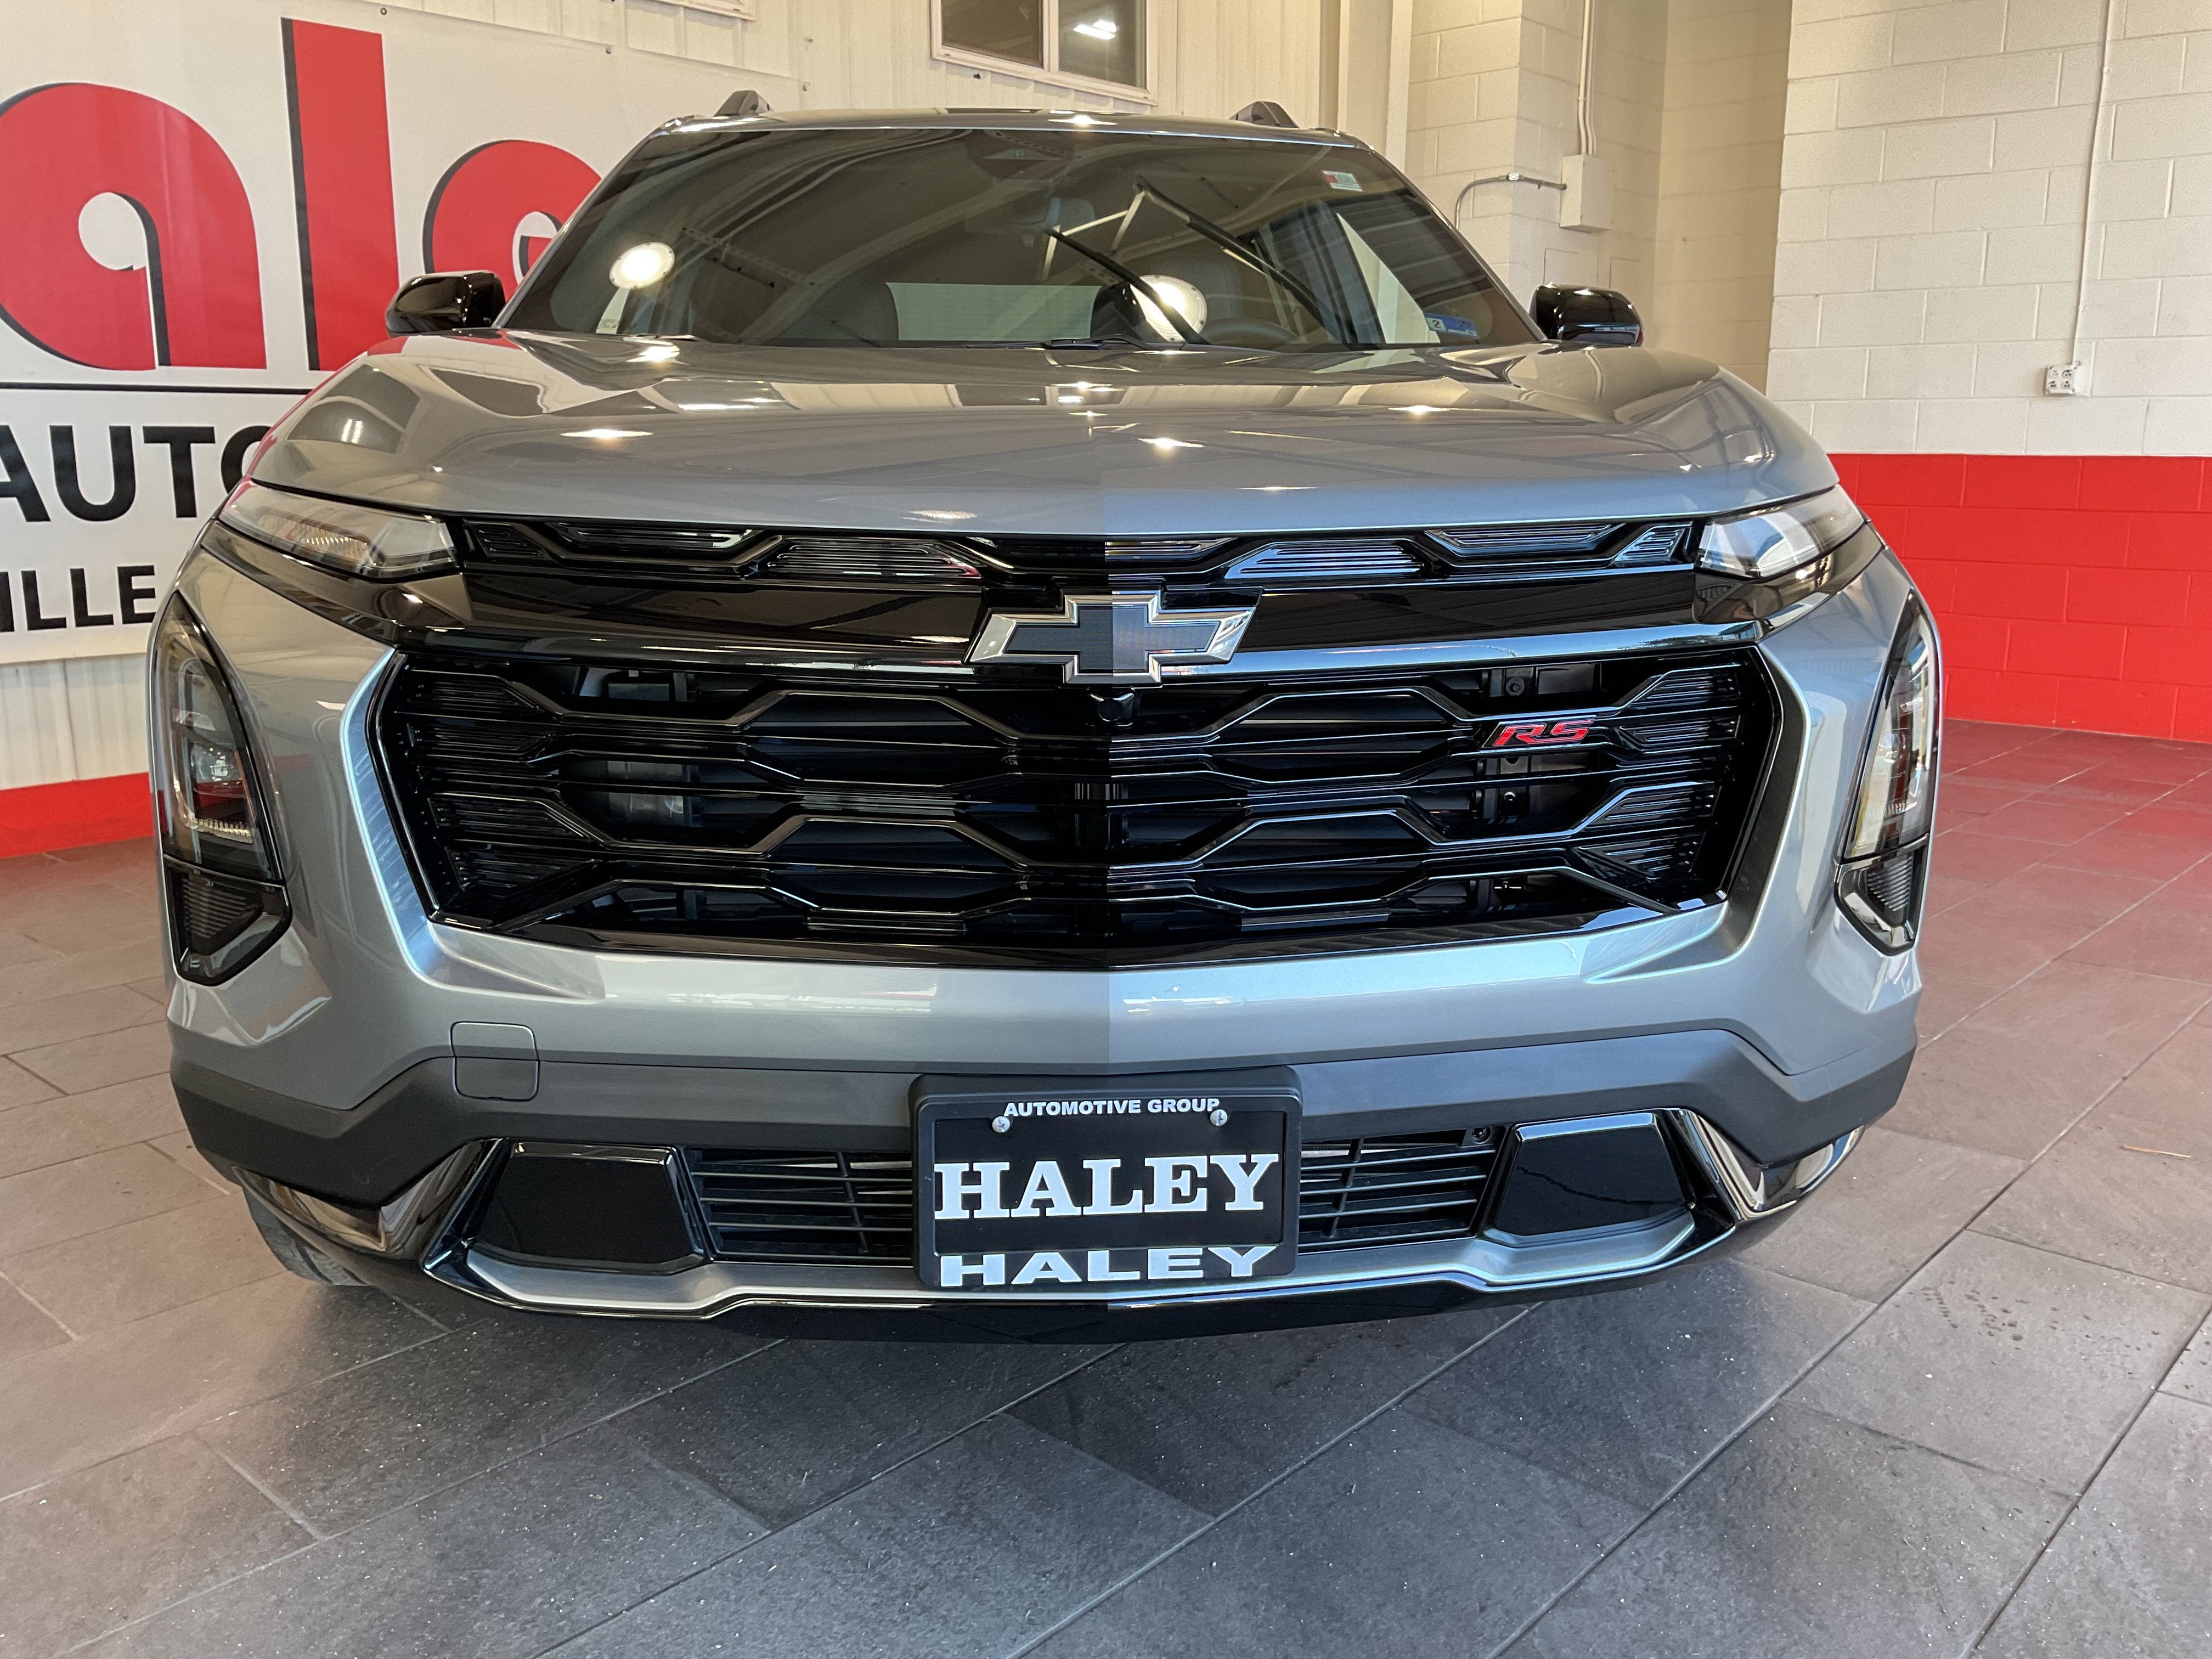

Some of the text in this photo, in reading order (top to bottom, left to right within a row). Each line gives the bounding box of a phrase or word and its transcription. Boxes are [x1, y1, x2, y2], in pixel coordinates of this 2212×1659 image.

[1492, 719, 1594, 747] RS
[1004, 1098, 1220, 1117] AUTOMOTIVE GROUP
[934, 1153, 1279, 1220] HALEY
[940, 1245, 1277, 1288] HALEY
